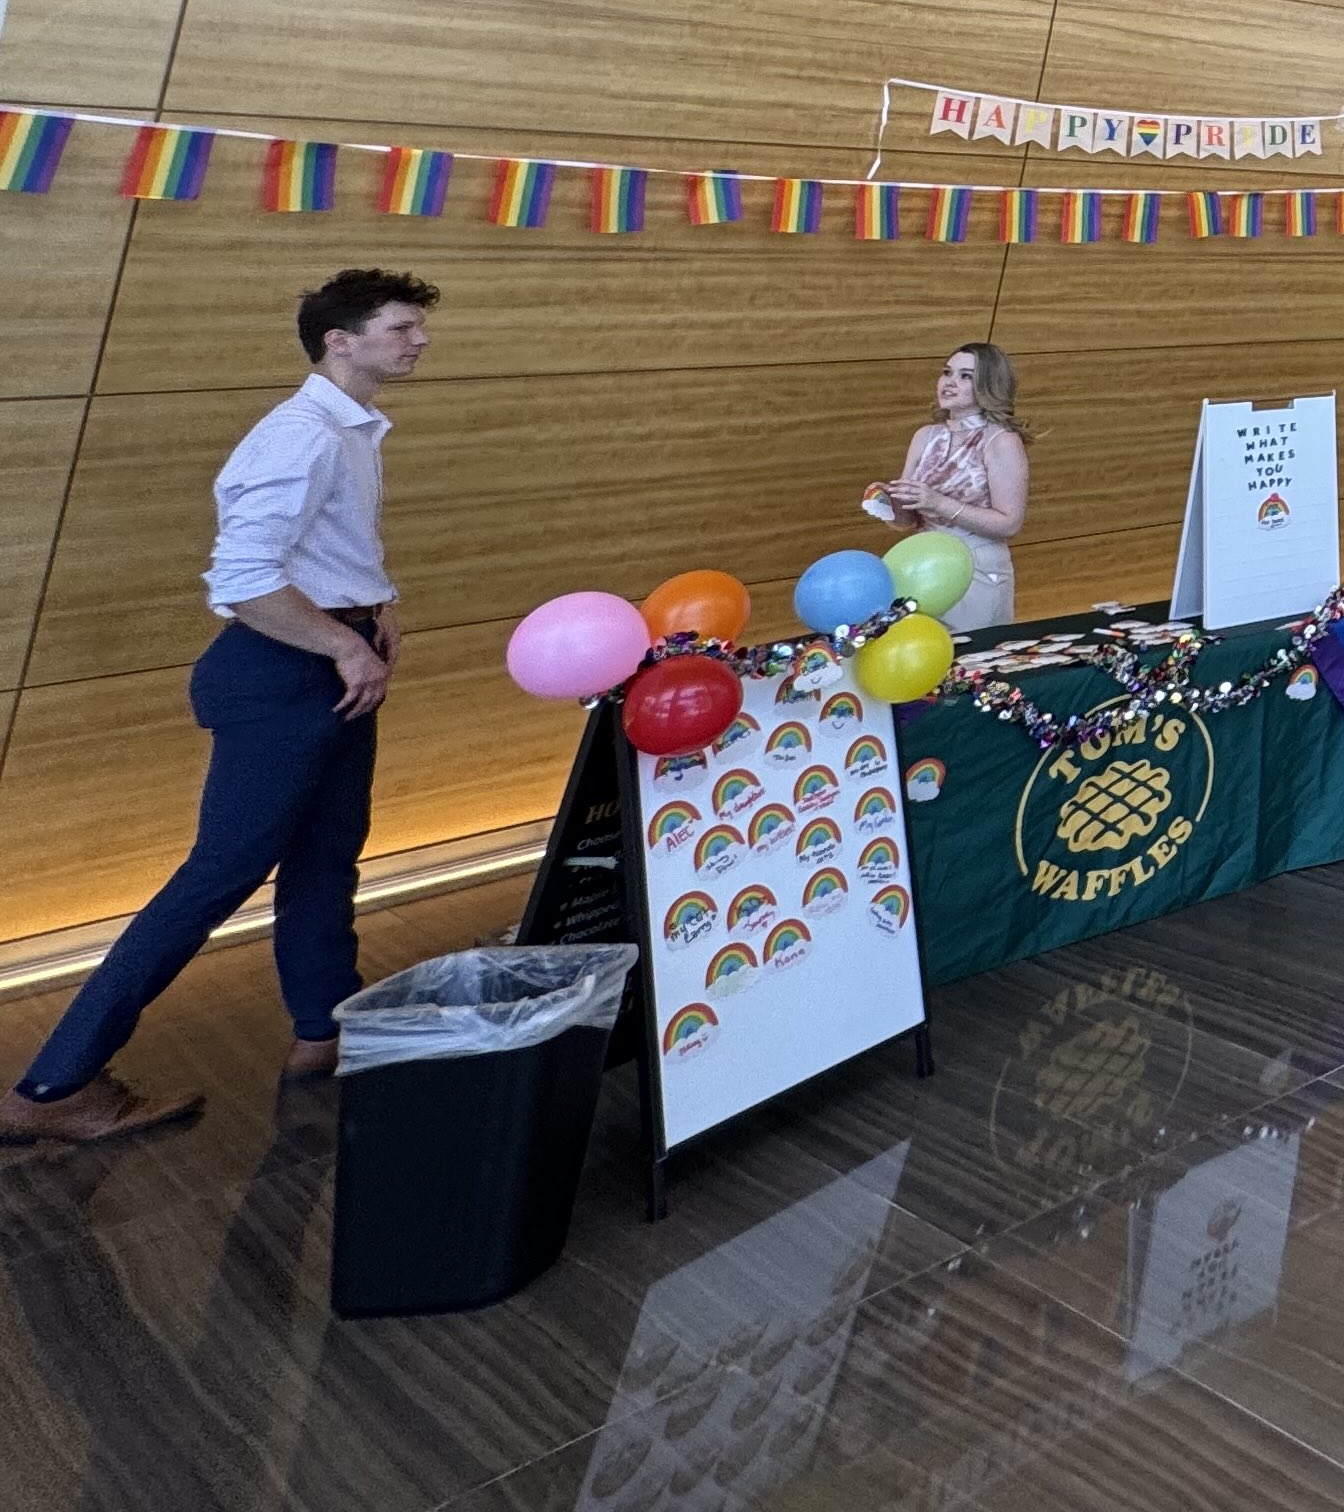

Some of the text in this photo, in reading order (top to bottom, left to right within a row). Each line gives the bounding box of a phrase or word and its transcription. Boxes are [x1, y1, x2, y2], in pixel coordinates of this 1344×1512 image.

[939, 97, 1316, 147] HAPPY PRIDE
[1237, 422, 1297, 438] WRITE
[1246, 436, 1289, 451] WHAT
[1244, 449, 1296, 464] MAKES
[1256, 463, 1284, 477] YOU
[1247, 477, 1293, 492] HAPPY
[1031, 815, 1193, 901] WAFFLES
